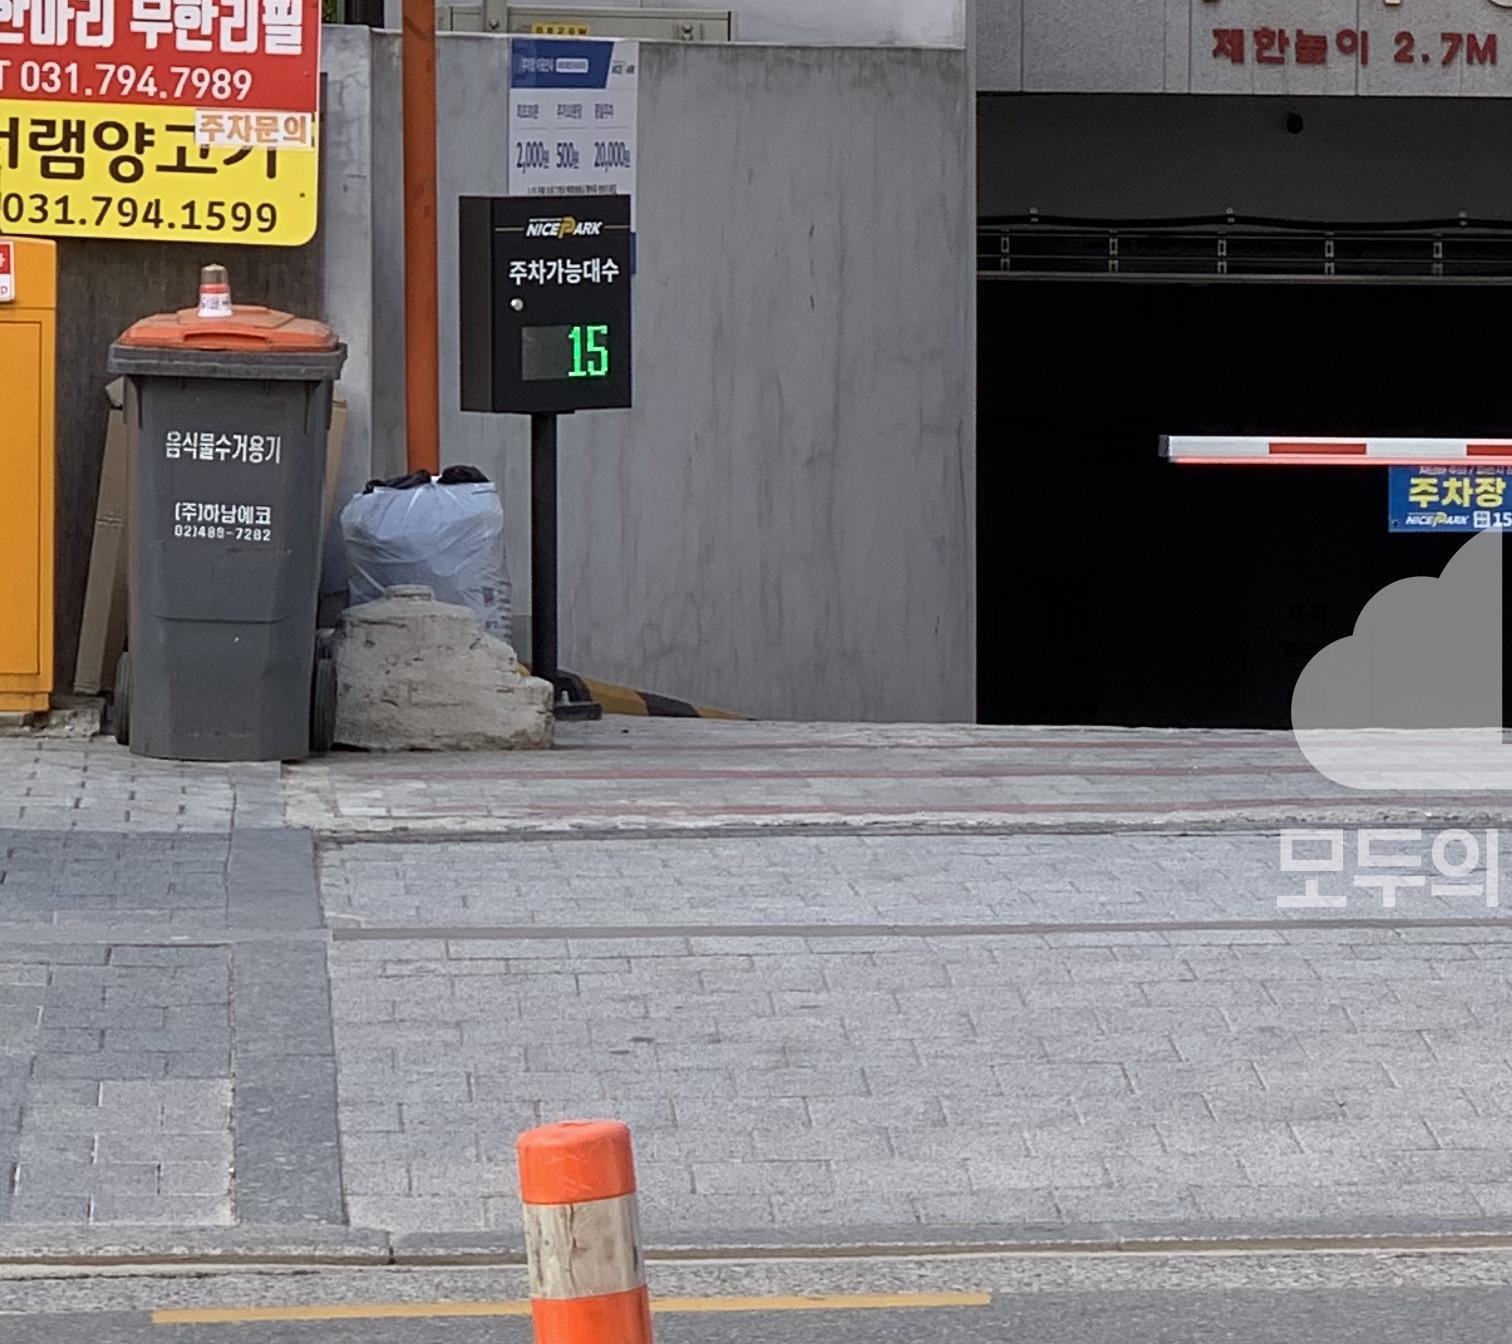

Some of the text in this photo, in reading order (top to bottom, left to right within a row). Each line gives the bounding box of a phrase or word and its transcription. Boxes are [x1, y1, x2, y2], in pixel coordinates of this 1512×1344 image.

[1394, 31, 1498, 66] 2.7M
[20, 60, 253, 101] 031.794.7989
[199, 114, 307, 145] 주차문의
[3, 192, 277, 232] 031.794.1599
[526, 216, 603, 239] NICEPARK
[508, 258, 620, 286] 주차가능대수
[567, 325, 609, 377] 15
[165, 431, 281, 465] 음식물수거용기
[1407, 476, 1507, 509] 주차장
